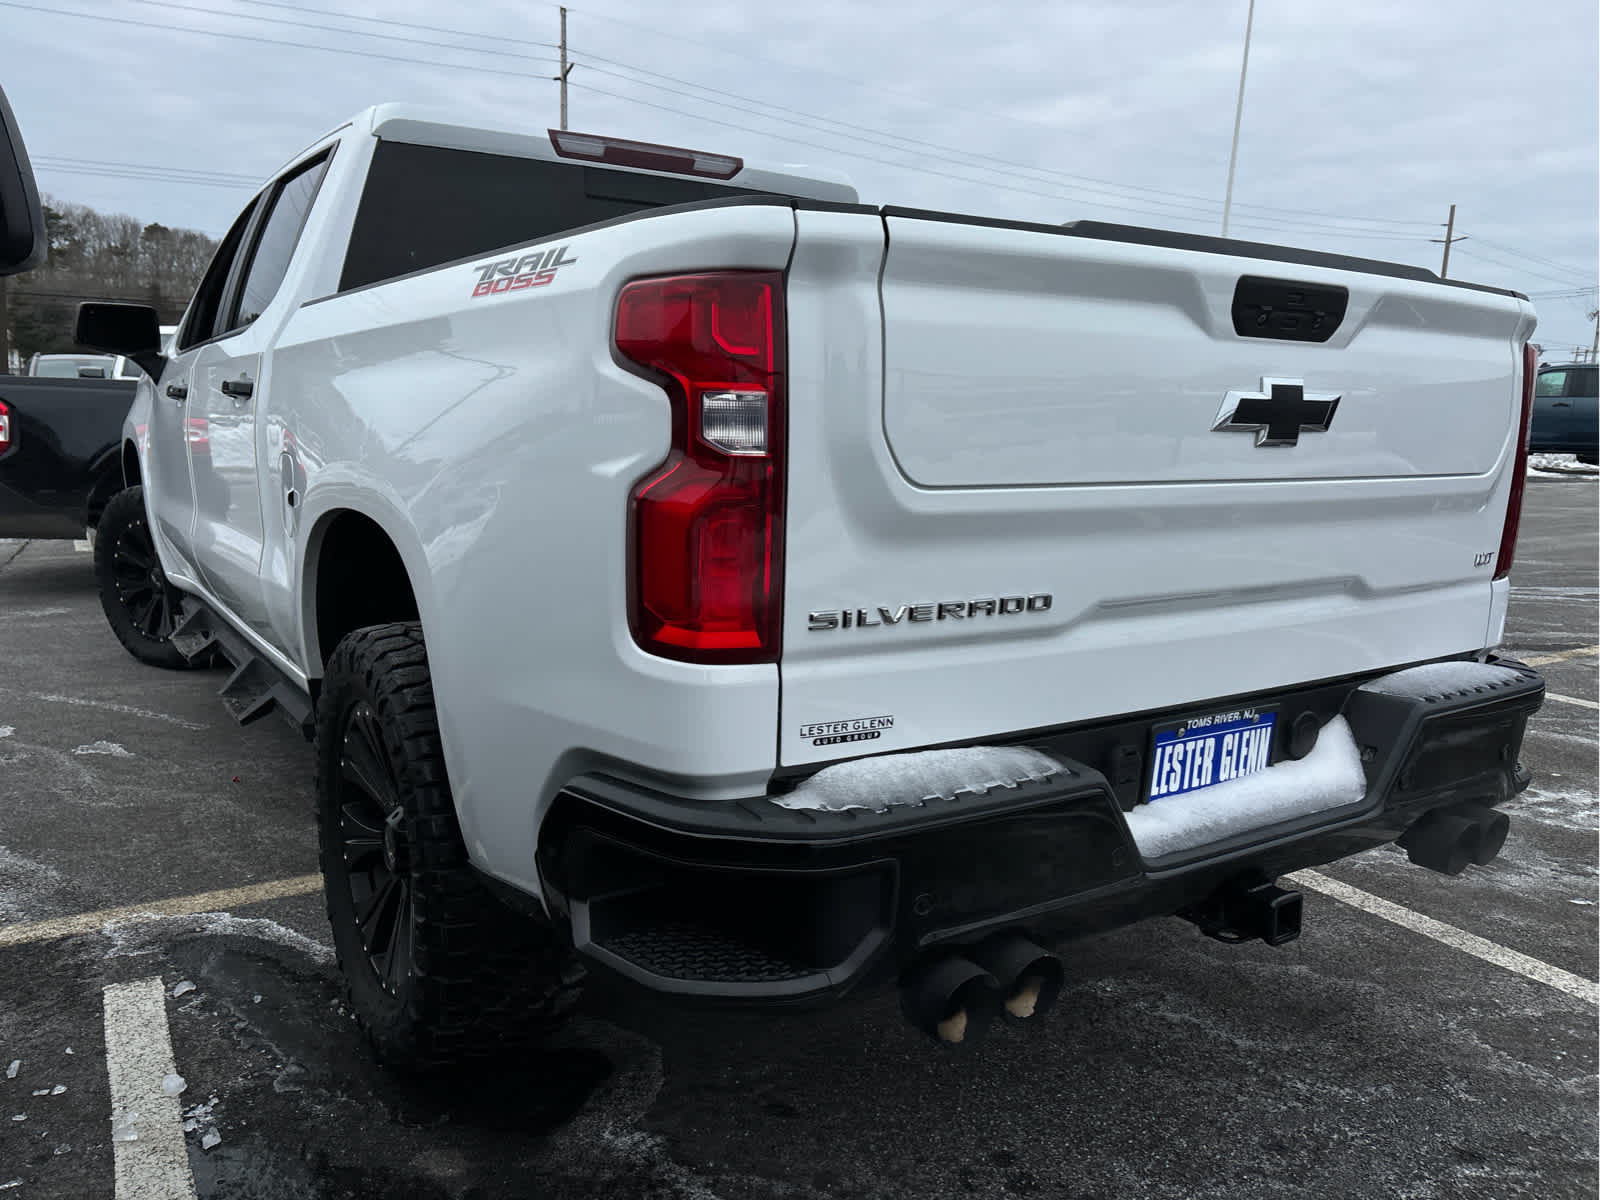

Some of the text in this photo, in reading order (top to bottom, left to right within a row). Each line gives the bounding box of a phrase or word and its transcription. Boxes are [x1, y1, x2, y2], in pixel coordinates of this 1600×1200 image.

[473, 246, 578, 281] TRAIL
[471, 267, 558, 297] BOSS
[808, 593, 1053, 631] SILVERADO
[800, 718, 894, 736] LESTER GLENN
[1187, 716, 1212, 729] TOMS
[1243, 708, 1255, 719] NJ
[815, 732, 879, 745] AUTO GROUP
[1150, 726, 1272, 796] LESTER GLENN
